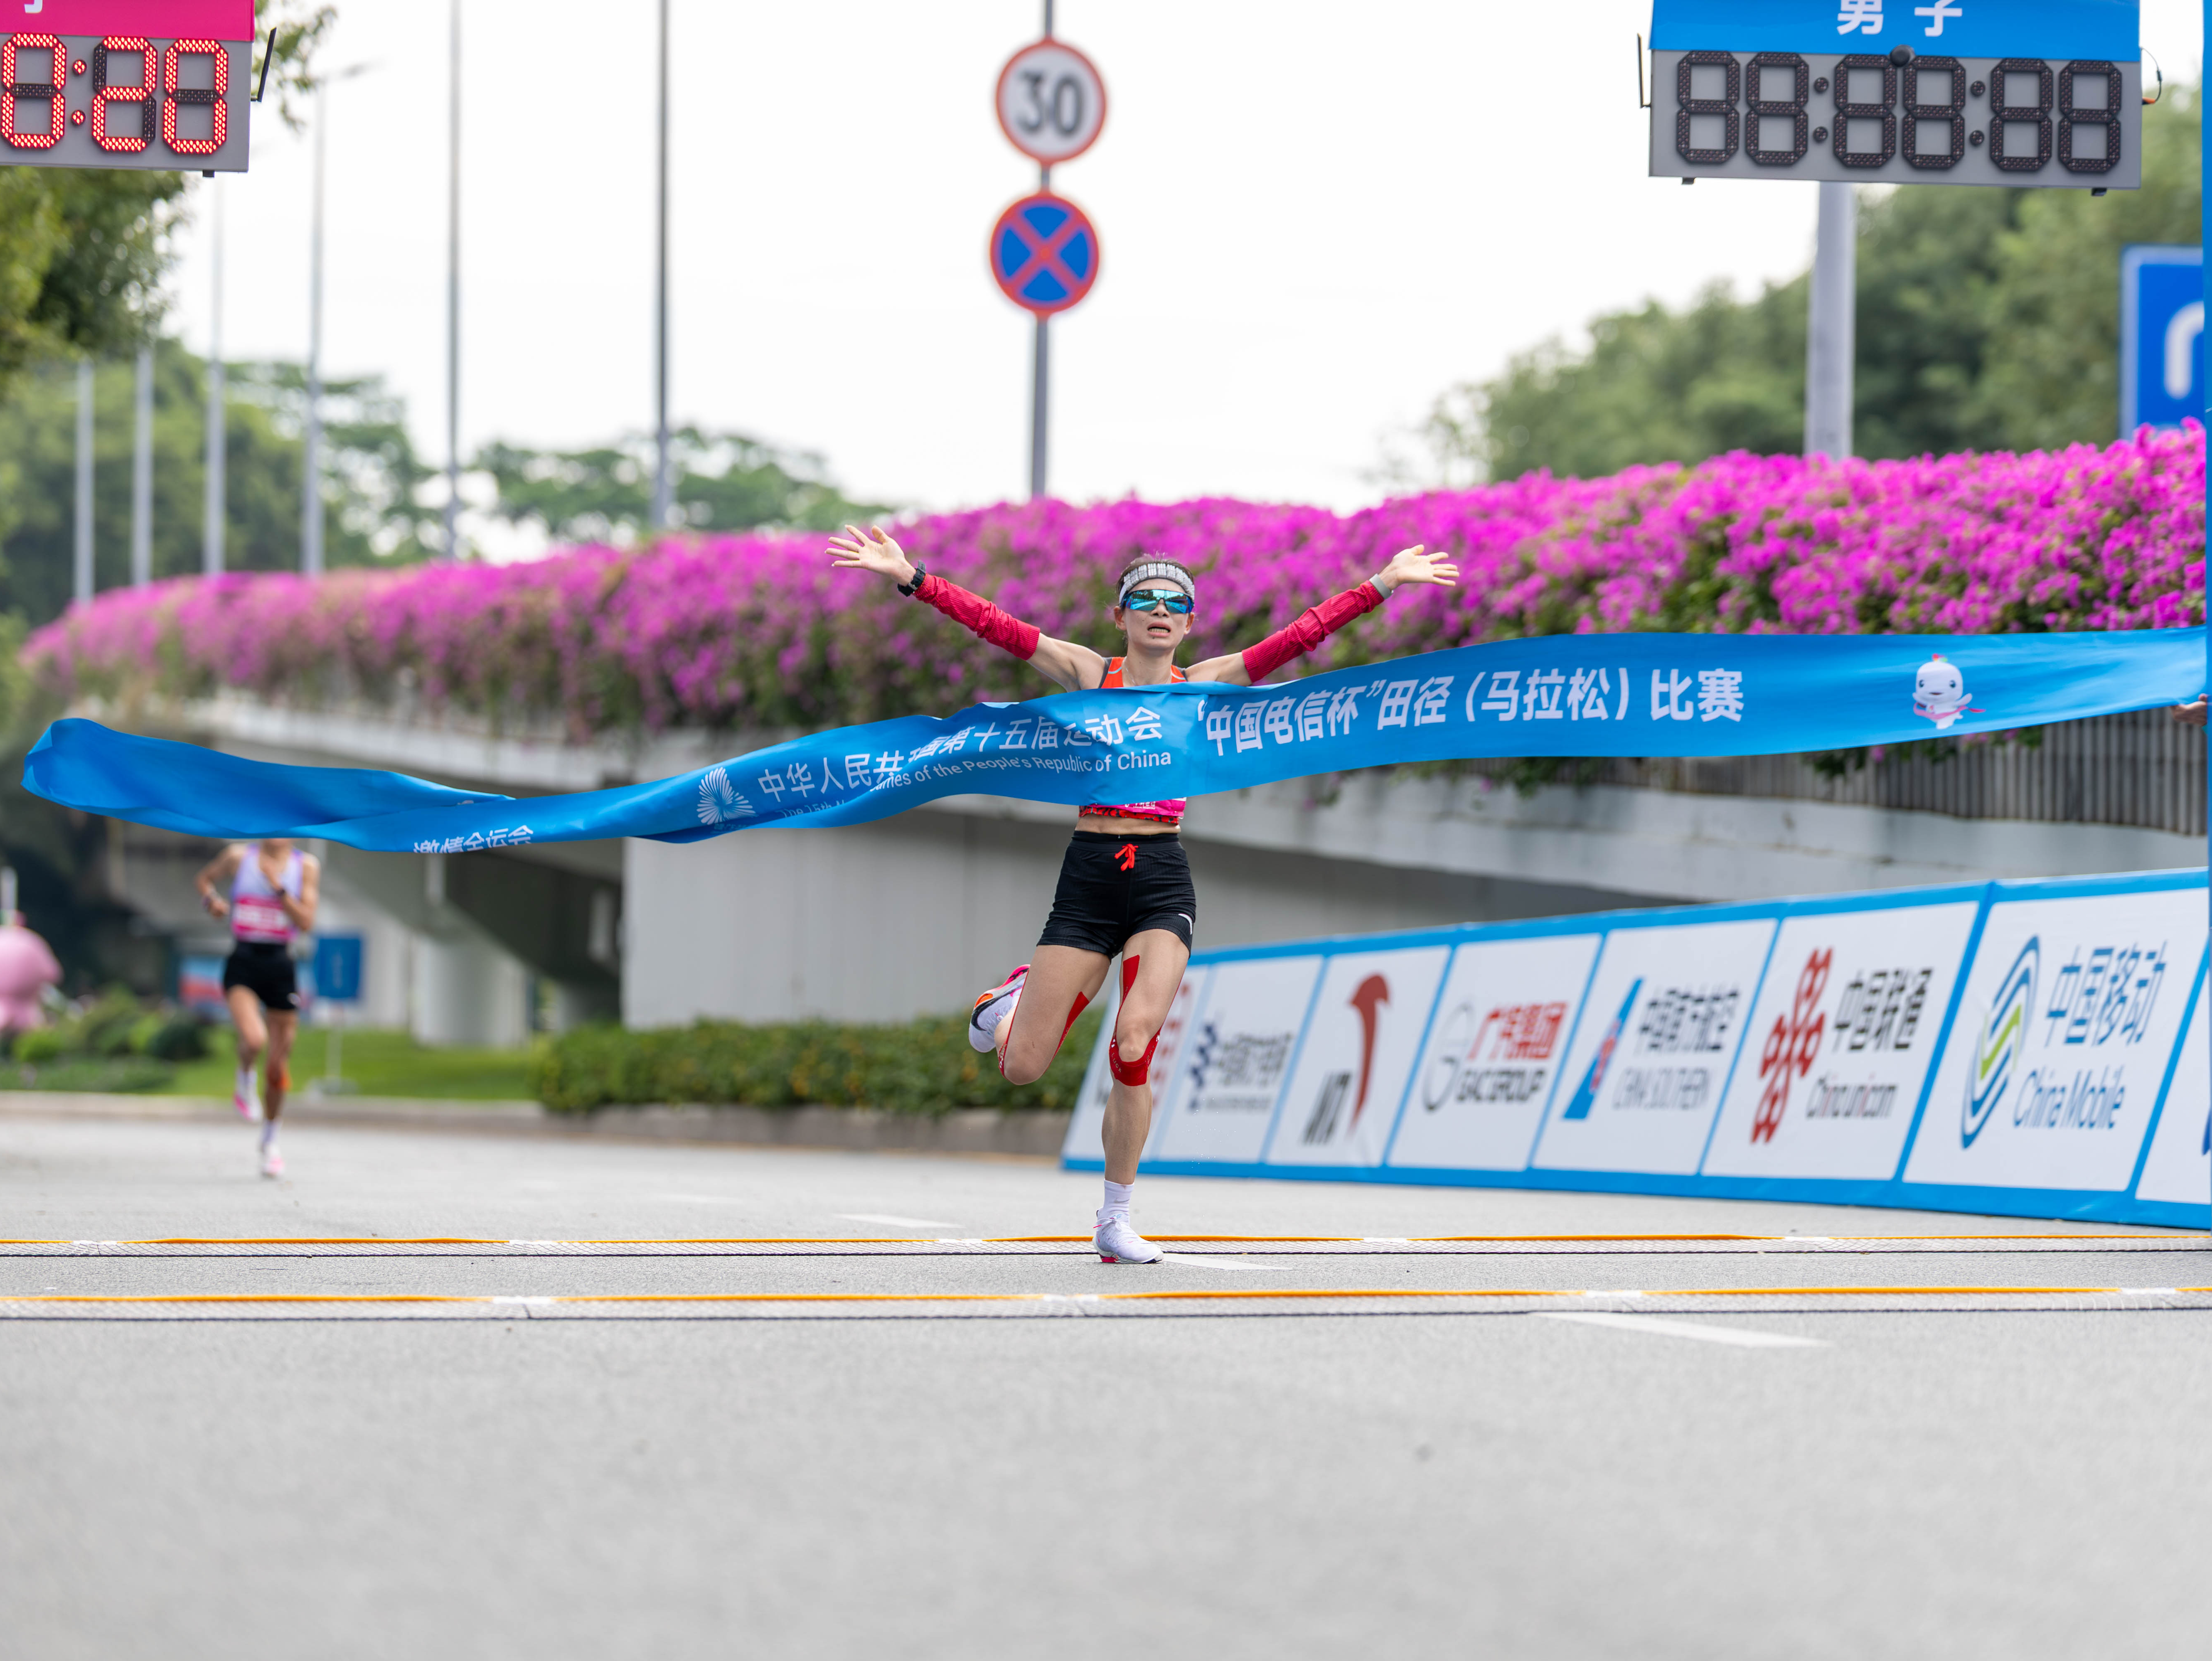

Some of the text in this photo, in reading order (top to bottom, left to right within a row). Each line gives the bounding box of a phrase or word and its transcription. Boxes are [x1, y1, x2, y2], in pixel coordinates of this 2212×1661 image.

[1837, 0, 1963, 37] 男子
[1016, 70, 1085, 138] 30
[757, 705, 1162, 803] 中华人民共国第十五届运动会
[915, 764, 932, 782] of
[933, 763, 963, 778] the
[962, 757, 1032, 772] People's
[1031, 754, 1092, 774] Republic
[1095, 754, 1112, 772] of
[1117, 749, 1171, 770] China
[2044, 940, 2168, 1049] 中国移动
[2014, 1065, 2126, 1130] China Mobile
